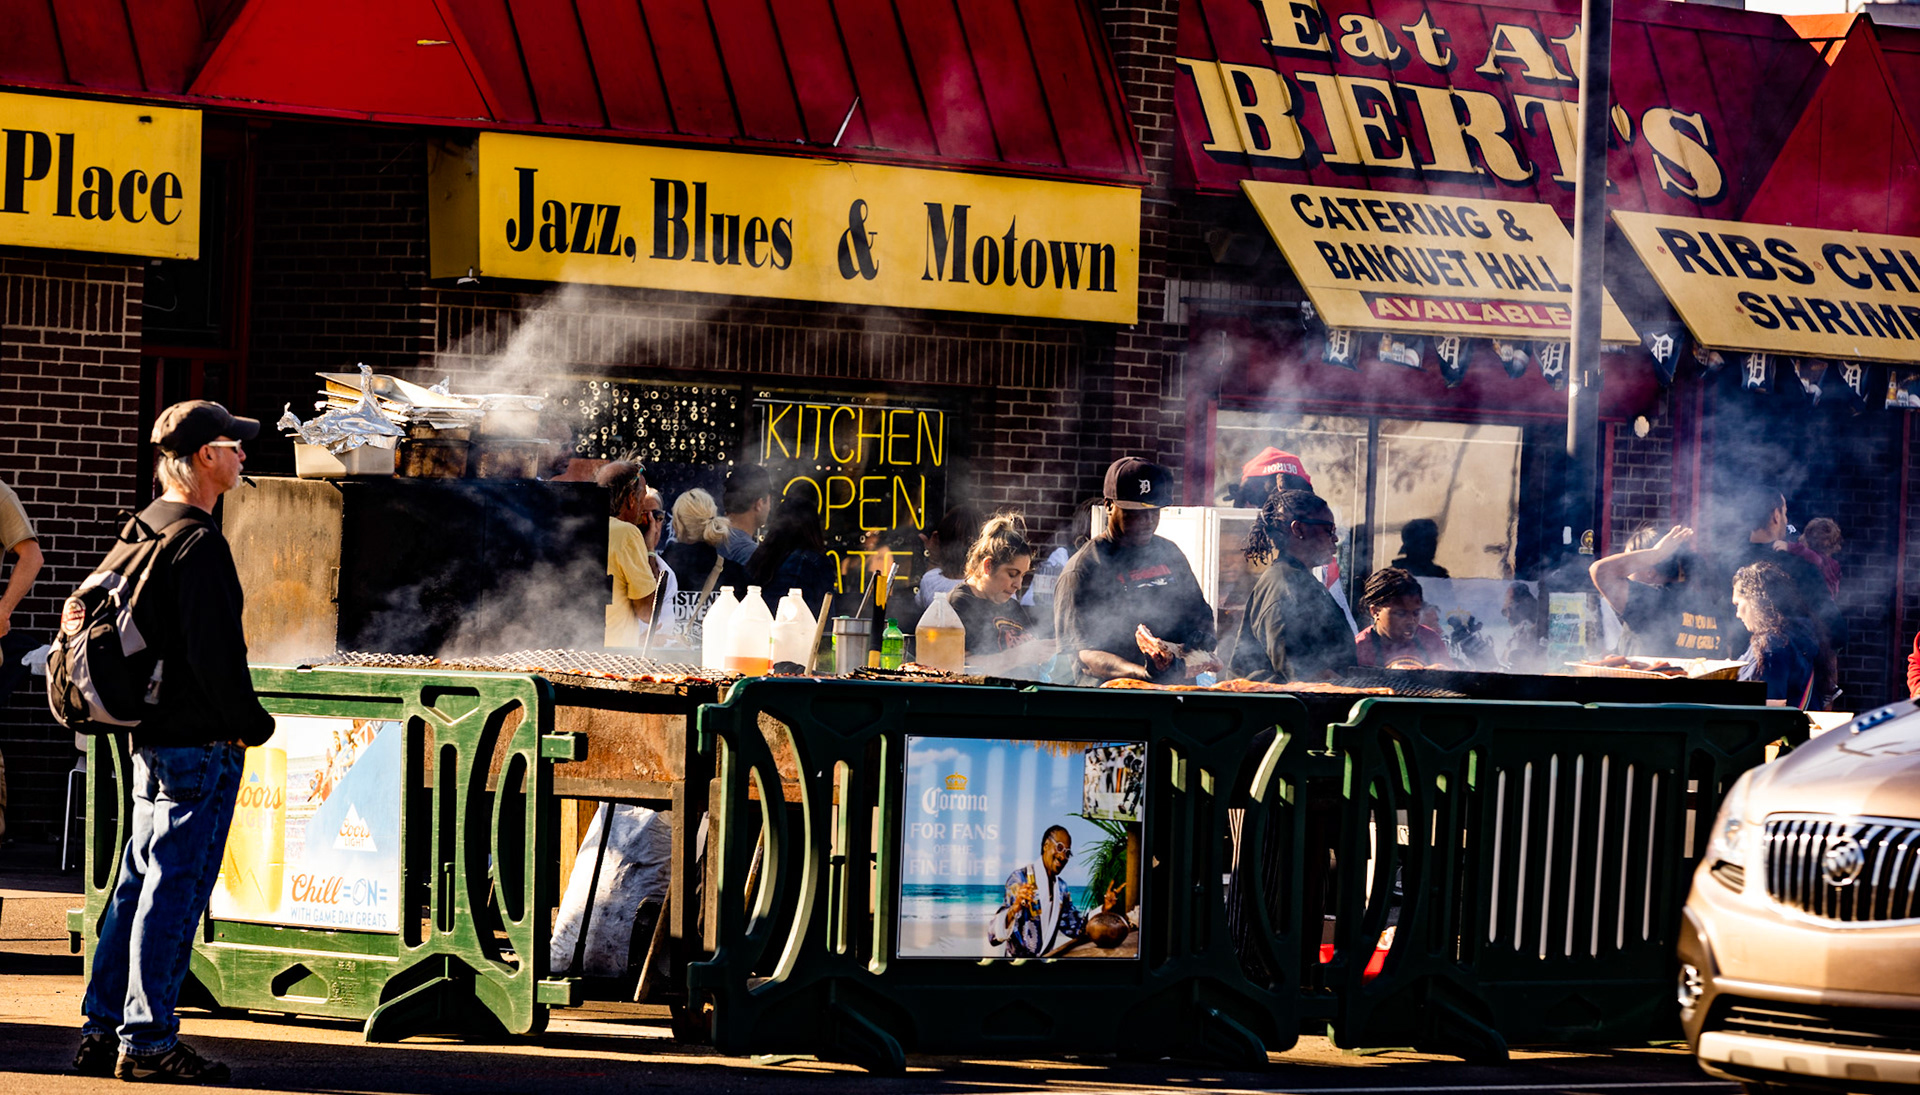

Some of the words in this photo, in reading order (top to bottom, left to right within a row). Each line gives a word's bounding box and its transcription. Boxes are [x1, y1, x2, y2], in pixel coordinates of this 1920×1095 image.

[1261, 0, 1452, 67] Eat
[1475, 22, 1583, 82] At
[1176, 57, 1724, 203] BERT'S
[0, 128, 183, 226] Place
[505, 167, 637, 263] Jazz,
[649, 177, 793, 271] Blues
[837, 198, 880, 280] &
[921, 202, 1118, 292] Motown
[1290, 193, 1492, 240] CATERING
[1496, 208, 1534, 242] &
[1314, 240, 1479, 288] BANQUET
[1475, 251, 1573, 294] HALL
[1655, 227, 1816, 285] RIBS
[1374, 297, 1572, 327] AVAILABLE
[765, 403, 944, 467] KITCHEN
[780, 475, 926, 531] OPEN
[825, 549, 914, 594] ATE
[921, 786, 988, 818] Corona
[339, 818, 371, 839] Coors
[344, 838, 365, 848] LIGHT
[910, 822, 946, 839] FOR
[952, 823, 1000, 840] FANS
[291, 873, 344, 905] Chill
[909, 859, 950, 876] FINE
[957, 860, 998, 877] LIFE
[291, 907, 311, 921] WITH
[313, 908, 337, 924] GAME
[339, 910, 355, 924] DAY
[356, 912, 388, 928] GREATS
